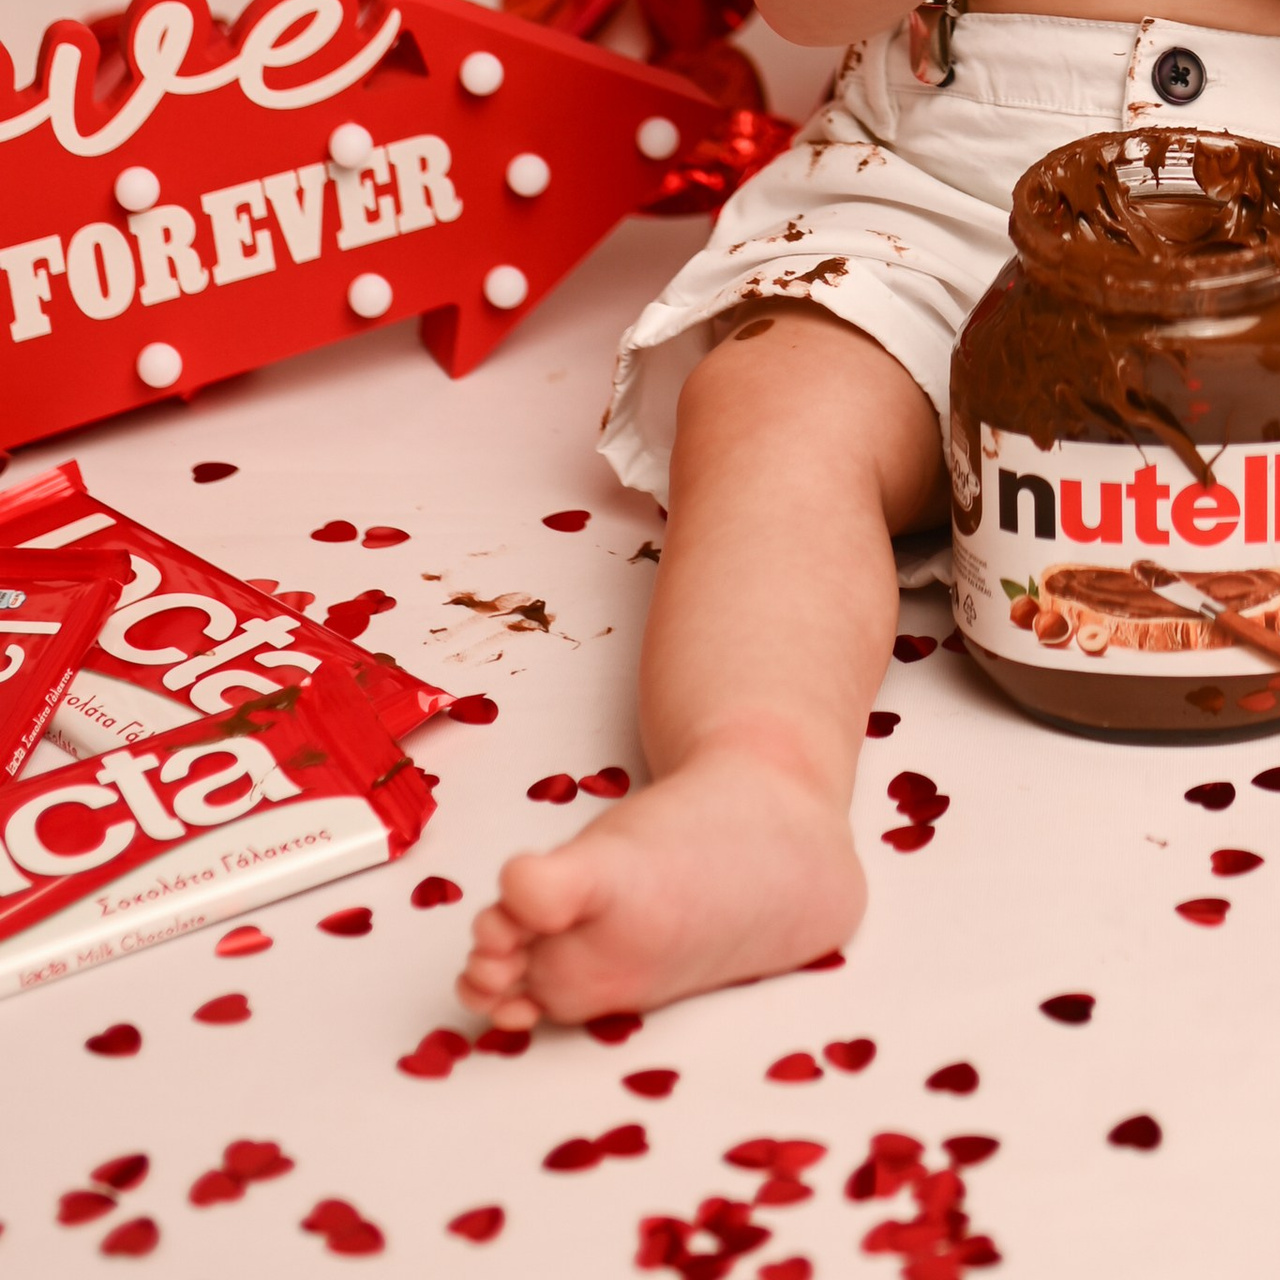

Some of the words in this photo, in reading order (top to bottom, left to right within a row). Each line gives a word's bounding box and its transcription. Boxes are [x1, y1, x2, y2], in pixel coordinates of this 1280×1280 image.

[0, 0, 402, 158] ve
[0, 134, 463, 343] FOREVER
[14, 512, 322, 716] cta
[65, 692, 117, 729] ολάτα
[0, 737, 303, 898] cta
